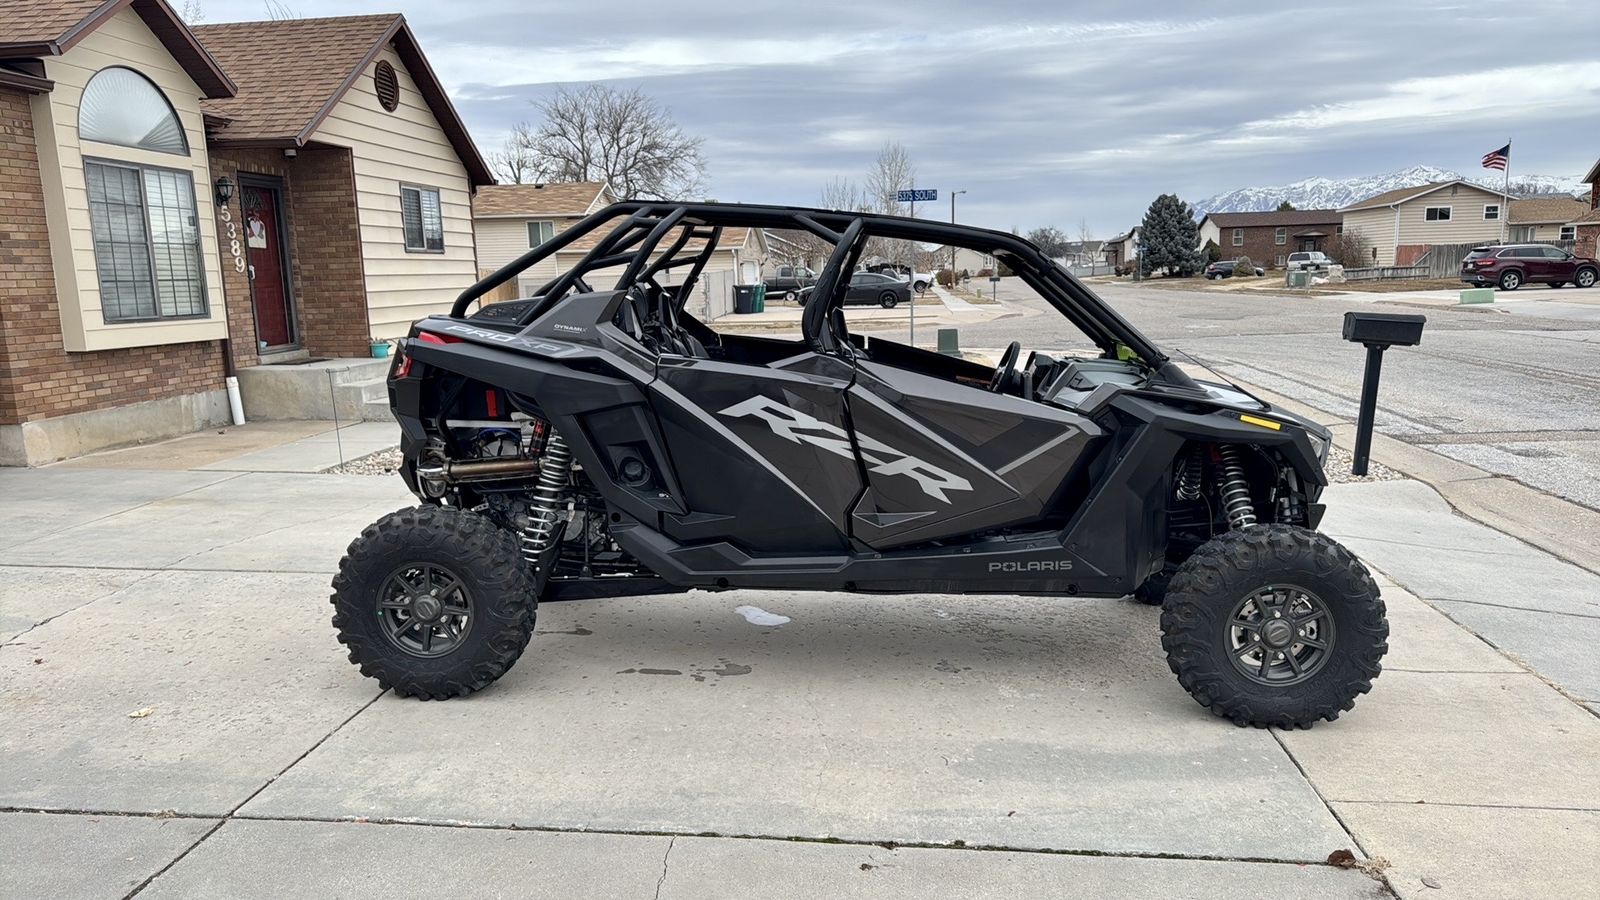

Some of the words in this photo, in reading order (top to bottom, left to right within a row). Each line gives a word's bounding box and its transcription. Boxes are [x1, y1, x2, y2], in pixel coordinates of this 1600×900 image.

[899, 191, 913, 200] 5375
[914, 190, 936, 200] SOUTH
[221, 205, 245, 273] 5389
[445, 325, 516, 342] PRO
[514, 336, 562, 352] XP
[717, 394, 974, 504] RZR
[988, 561, 1073, 573] POLARIS
